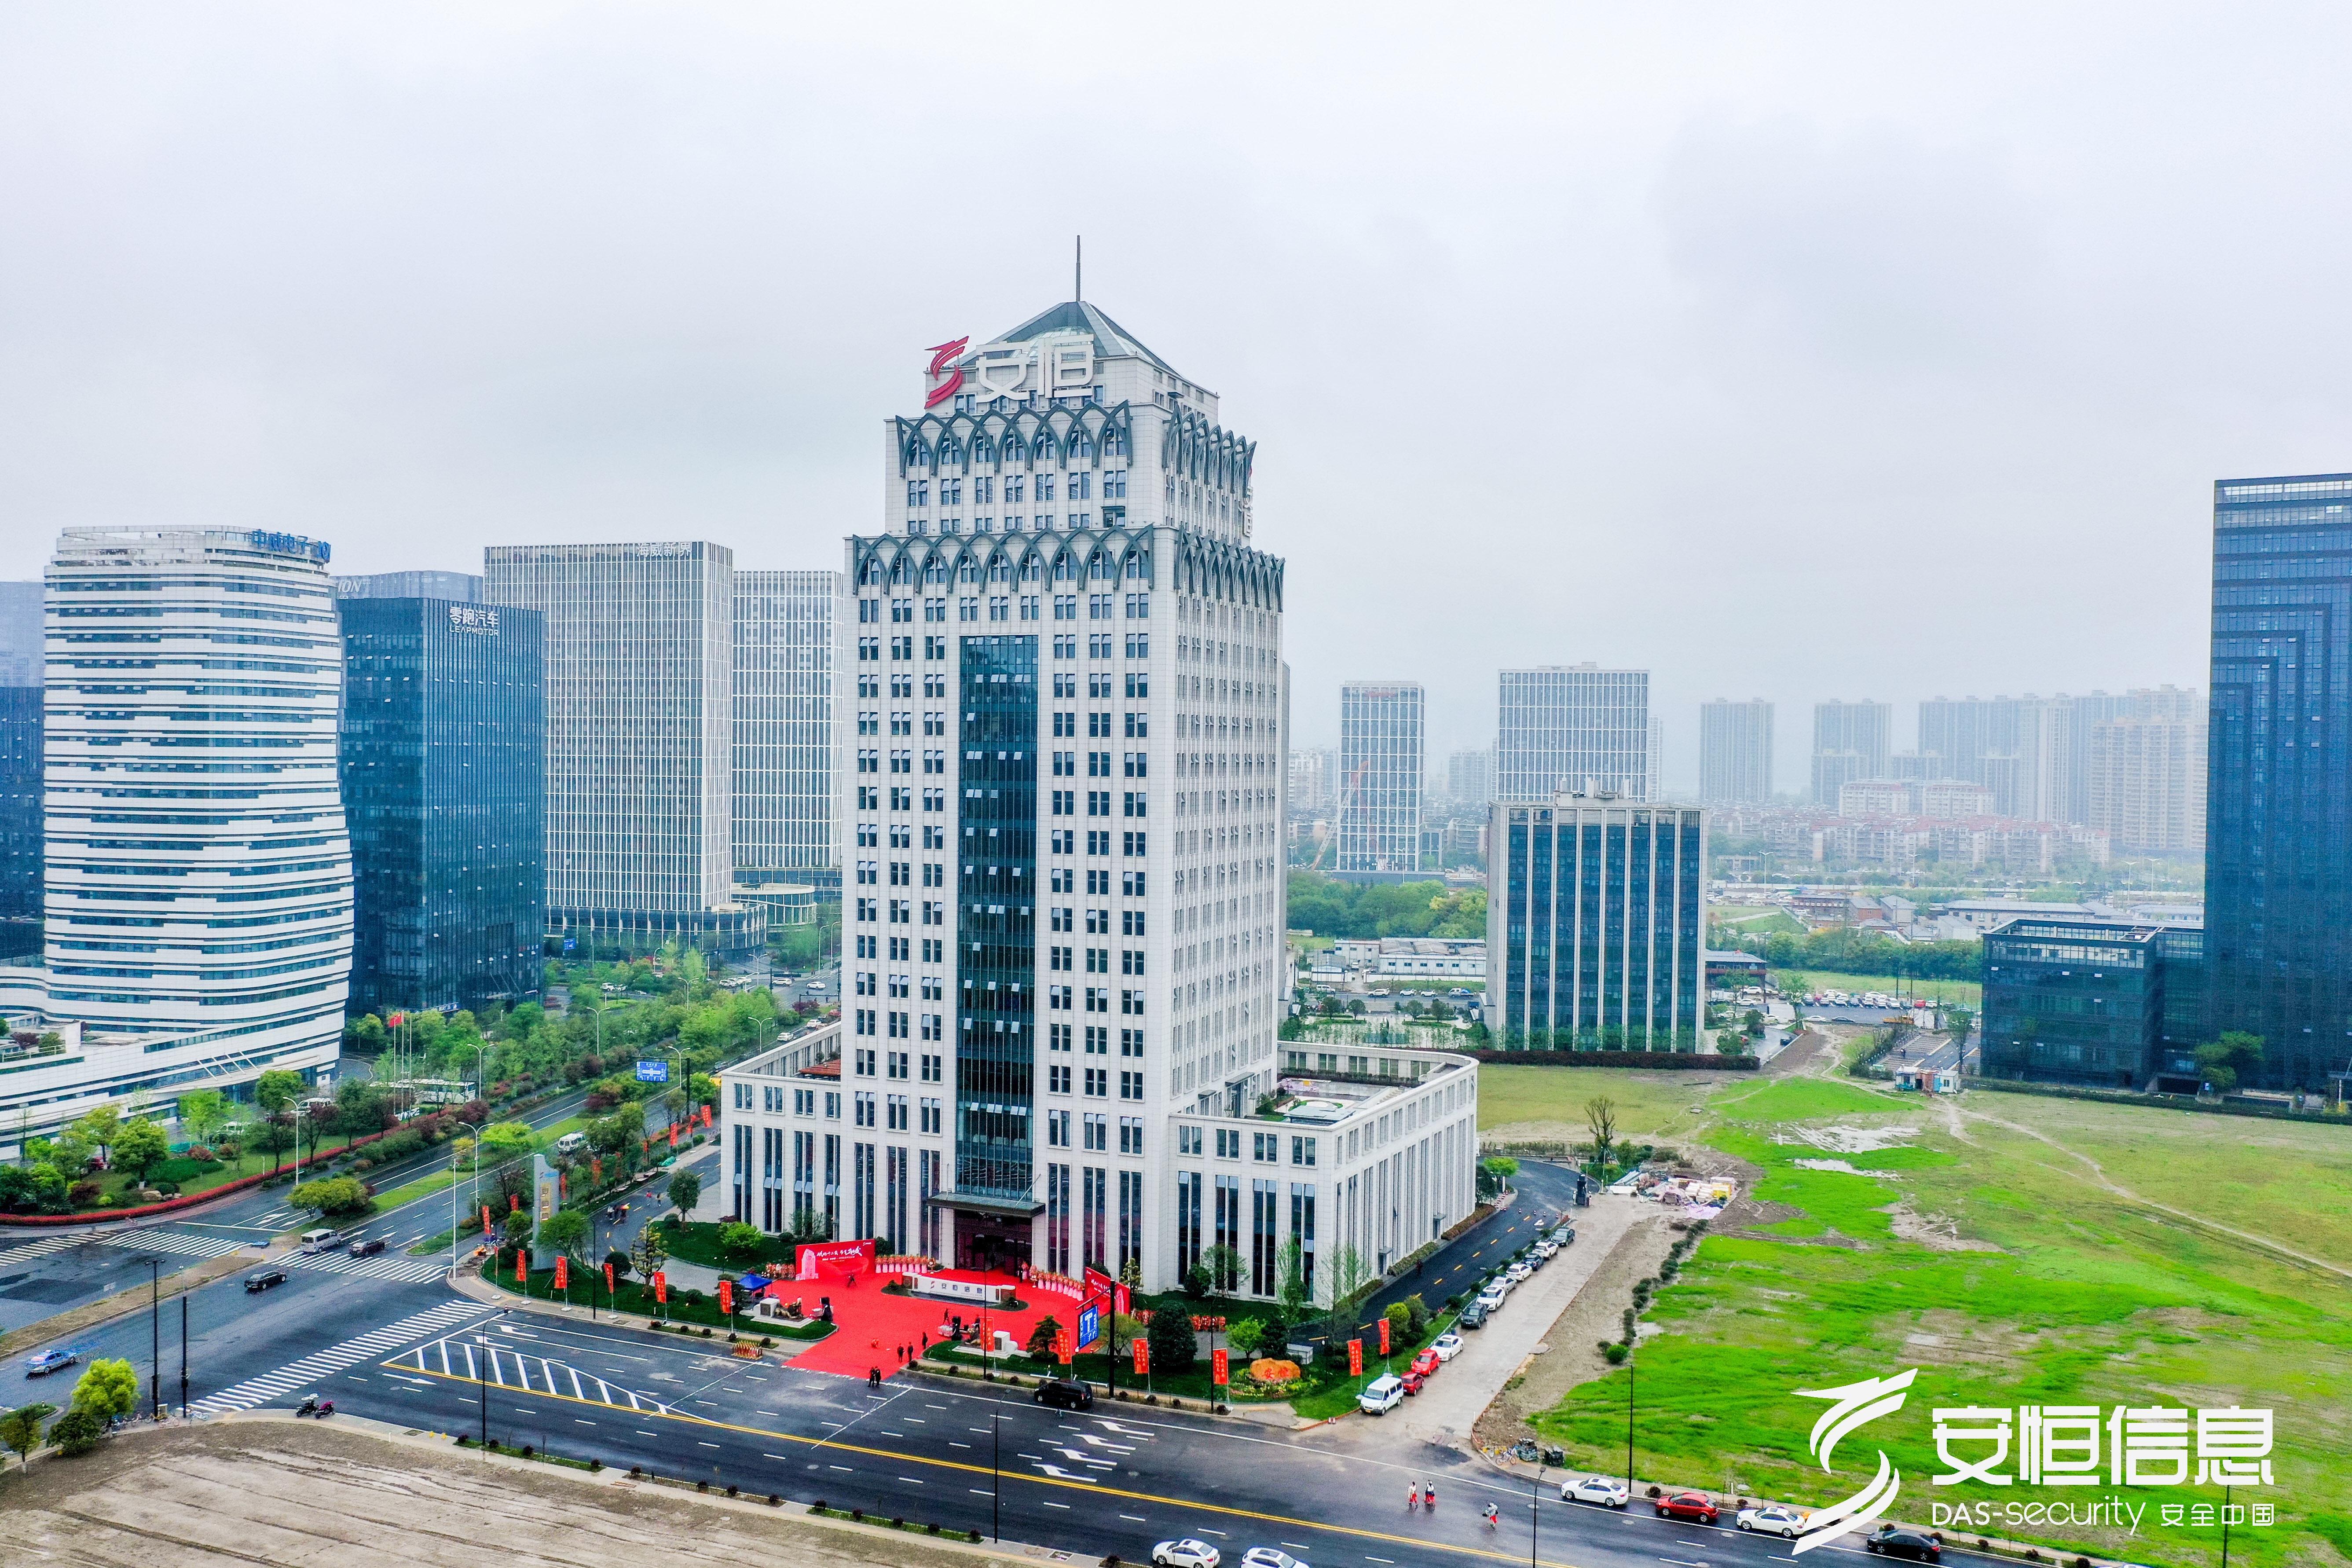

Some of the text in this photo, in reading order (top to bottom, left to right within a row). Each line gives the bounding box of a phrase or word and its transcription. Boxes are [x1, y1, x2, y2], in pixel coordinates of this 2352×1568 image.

[637, 542, 692, 557] 海威新界
[450, 607, 498, 628] 零跑汽车
[449, 625, 498, 636] LEAPMOTOR
